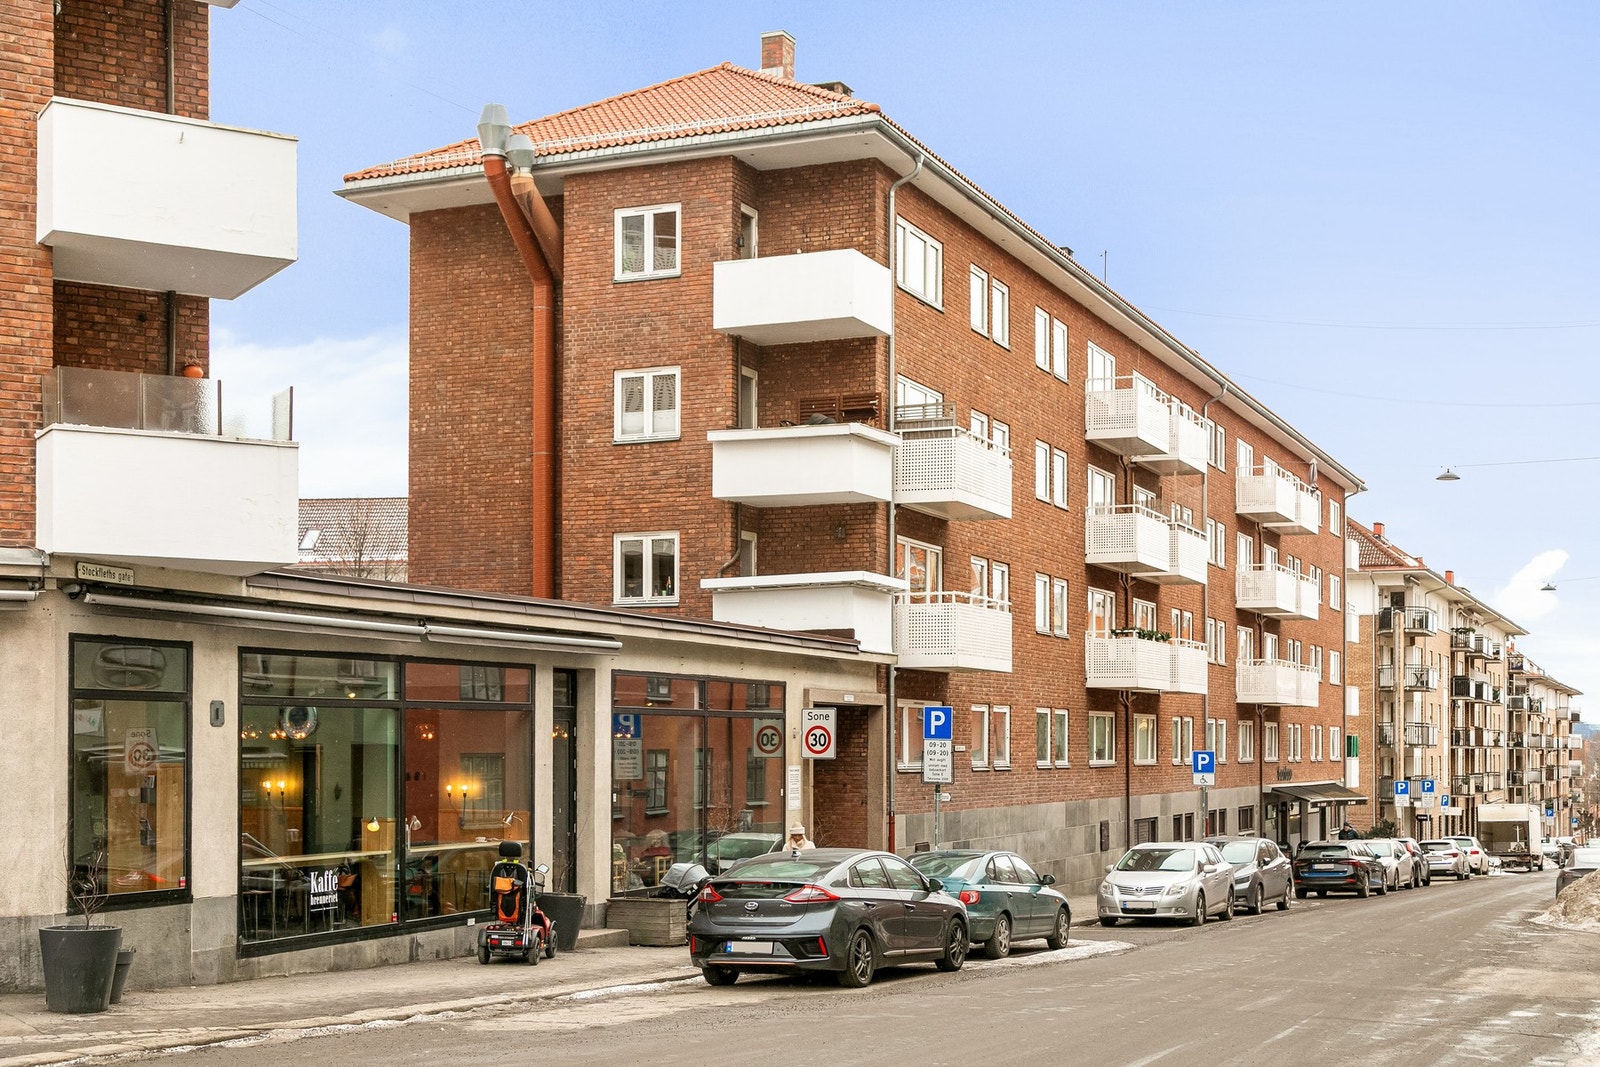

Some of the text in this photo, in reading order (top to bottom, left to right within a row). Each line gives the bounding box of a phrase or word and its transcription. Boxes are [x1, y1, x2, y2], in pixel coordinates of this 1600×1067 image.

[81, 564, 131, 582] Stockfleths gate
[807, 711, 830, 721] Sone
[930, 710, 946, 735] P
[810, 733, 827, 747] 30
[1197, 754, 1210, 770] P
[1397, 783, 1406, 794] P
[1424, 782, 1432, 791] P
[1442, 795, 1448, 805] P
